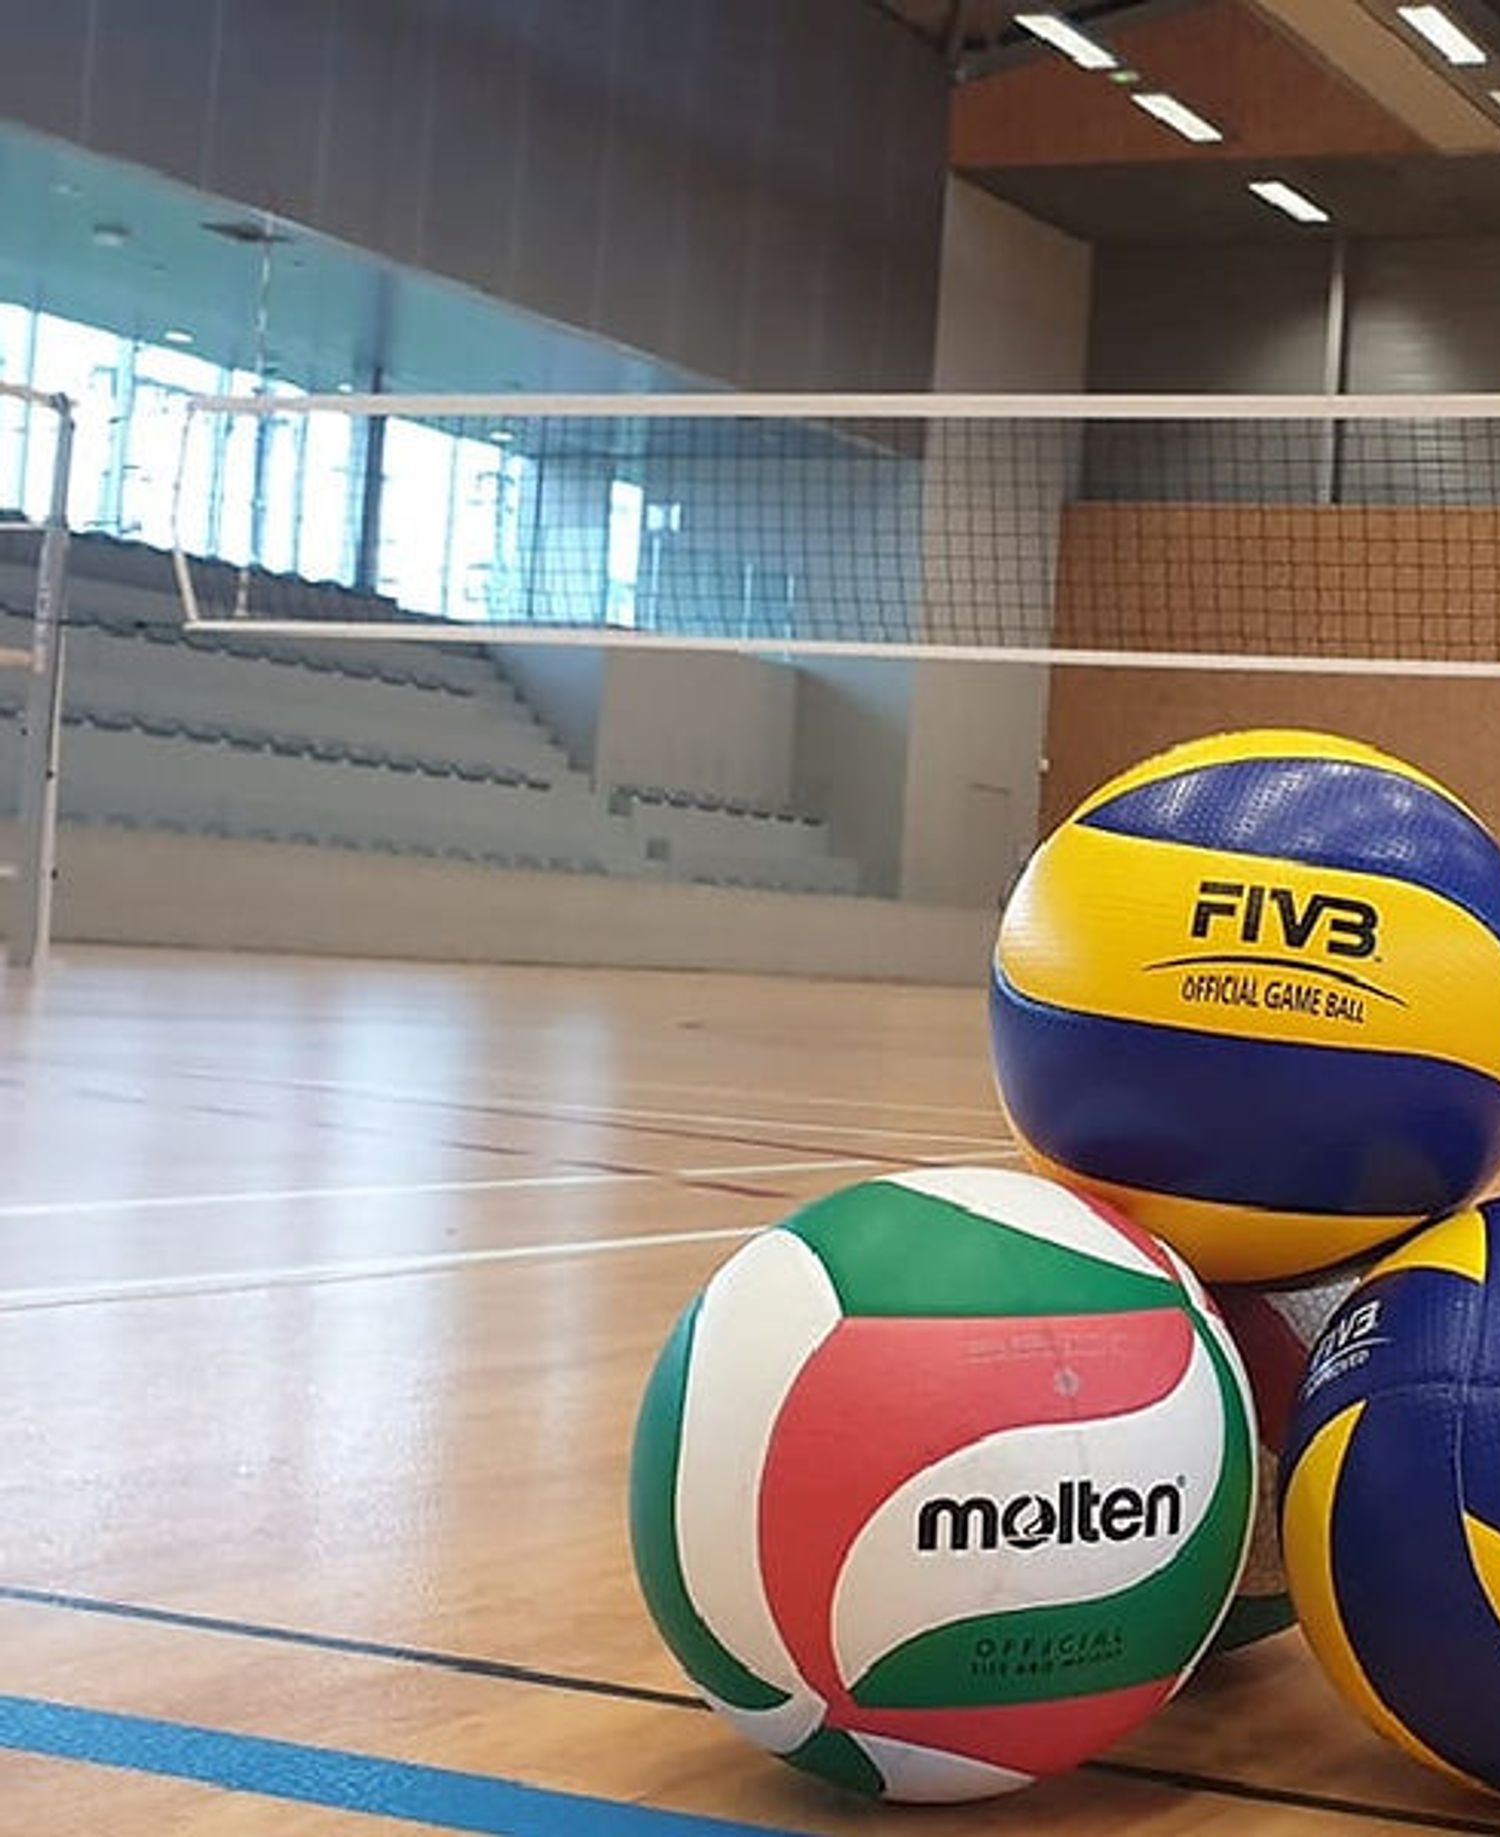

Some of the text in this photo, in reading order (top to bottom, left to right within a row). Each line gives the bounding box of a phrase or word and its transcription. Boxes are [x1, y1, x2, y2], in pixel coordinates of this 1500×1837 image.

[1190, 880, 1380, 959] FIVB
[1182, 975, 1365, 1024] OFFICIAL GAME BALL
